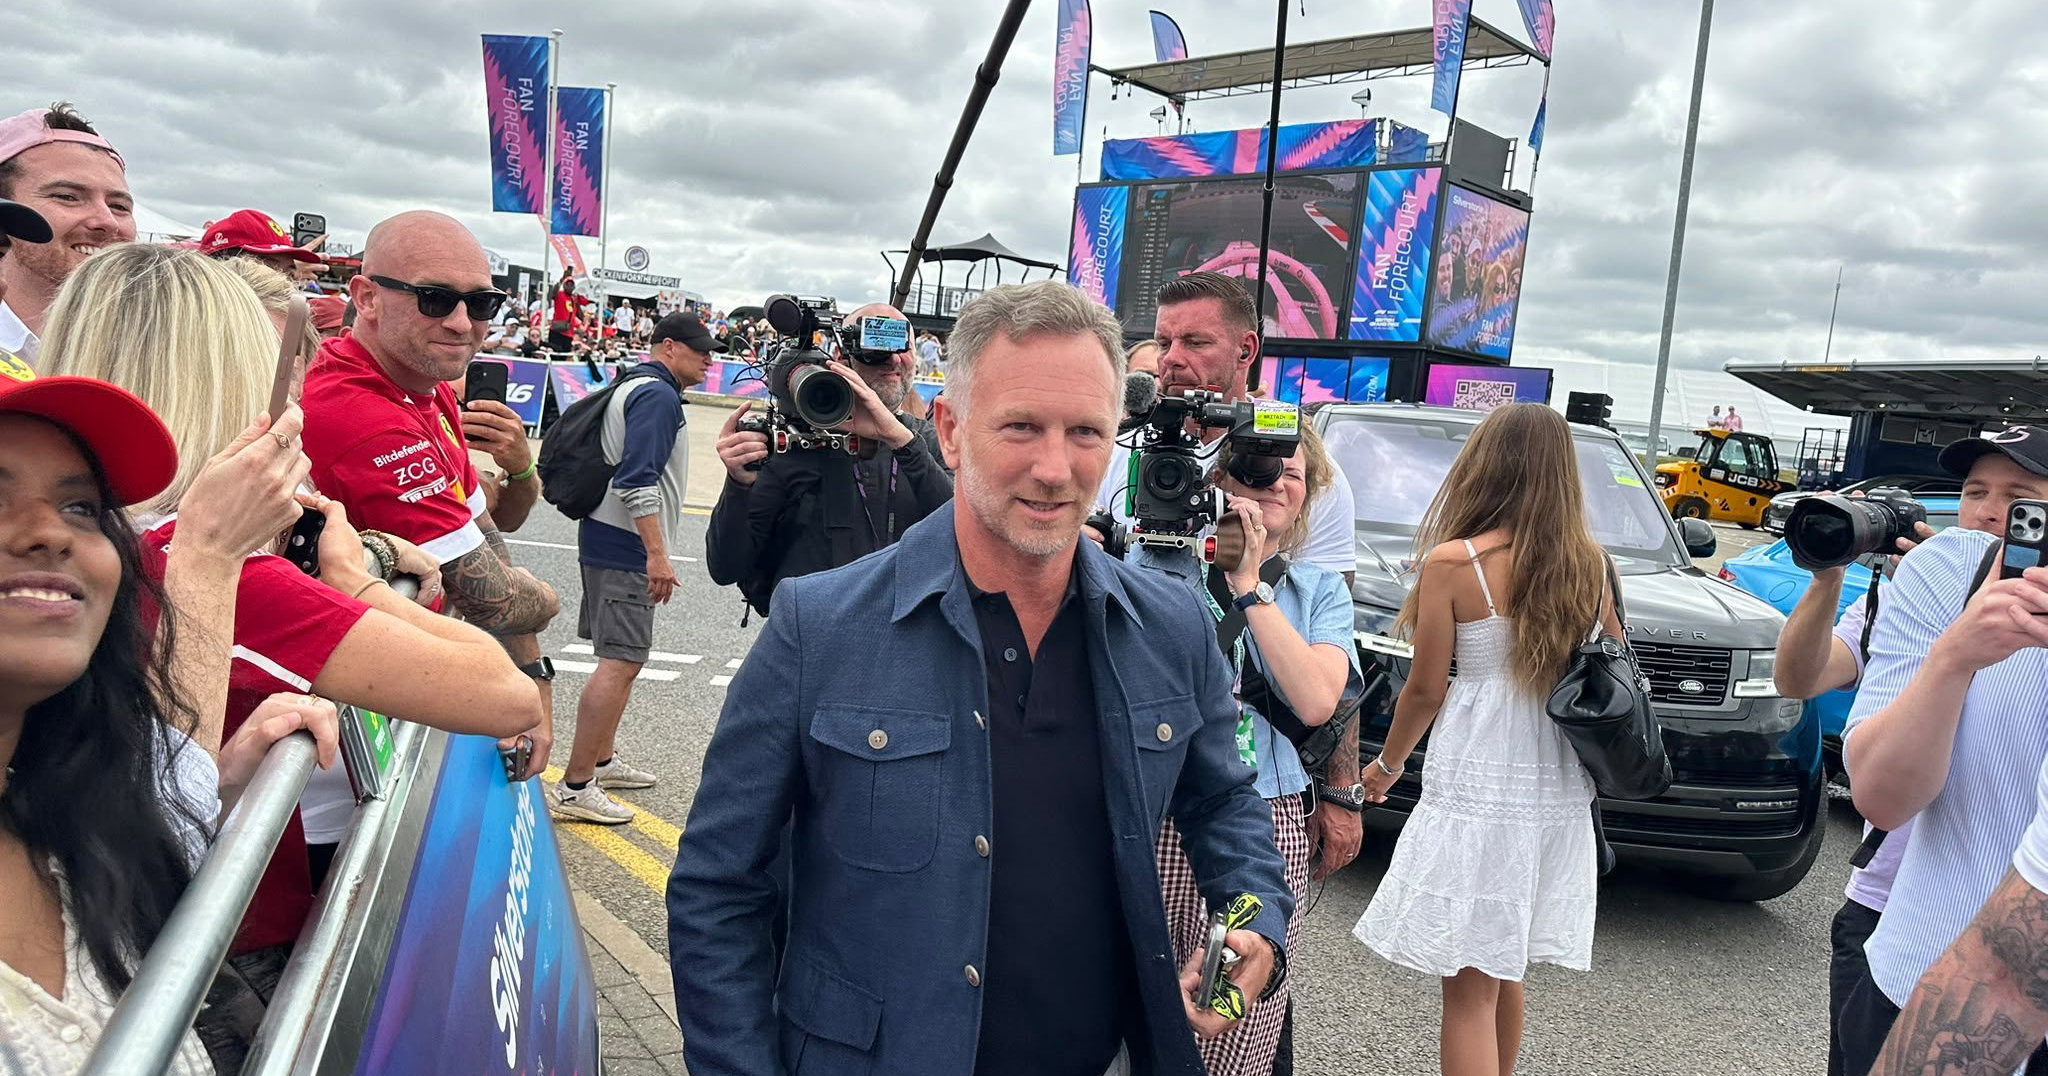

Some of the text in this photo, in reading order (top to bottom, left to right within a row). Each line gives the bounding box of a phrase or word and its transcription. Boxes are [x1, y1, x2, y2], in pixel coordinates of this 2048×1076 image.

[518, 77, 534, 112] FAN
[501, 87, 523, 189] FORECOURT
[576, 122, 588, 150] FAN
[561, 130, 575, 214] FORECOURT
[1091, 204, 1112, 298] FORECOURT
[1389, 189, 1418, 301] FORECOURT
[592, 268, 621, 281] CHCKEN
[1080, 257, 1094, 288] FAN
[1372, 253, 1392, 290] FAN
[373, 440, 431, 468] Bitdefende
[393, 457, 437, 486] ZCG
[1728, 473, 1758, 487] JCB
[1626, 625, 1707, 640] OVER
[1231, 900, 1247, 916] VIP
[490, 781, 535, 1069] Silverstone
